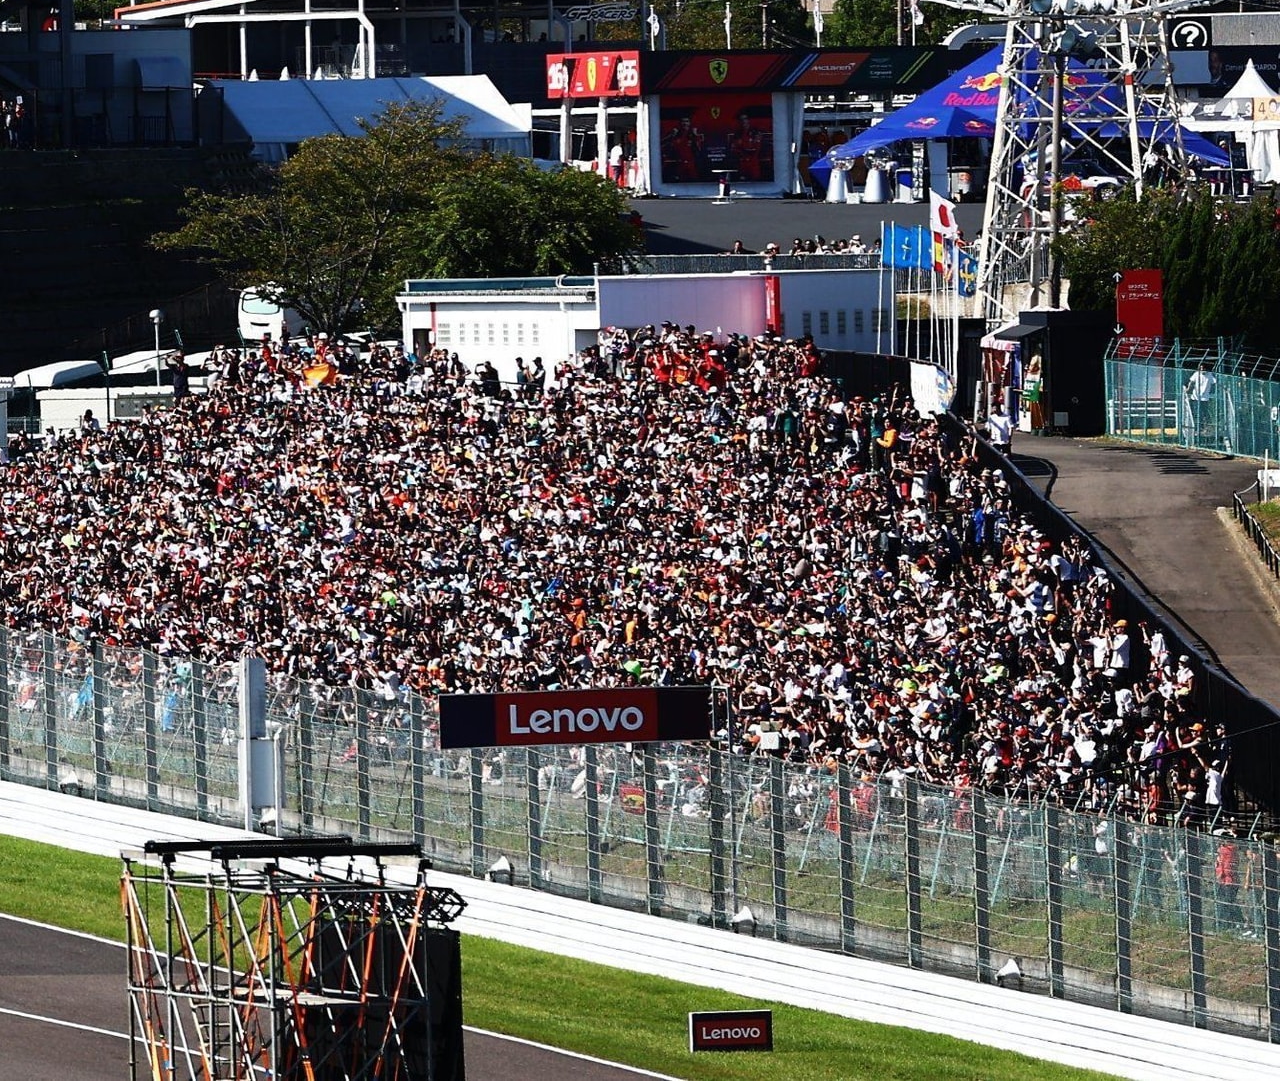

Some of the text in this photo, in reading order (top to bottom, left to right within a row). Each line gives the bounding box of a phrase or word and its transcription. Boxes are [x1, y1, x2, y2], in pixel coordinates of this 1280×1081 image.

[590, 7, 637, 20] RACERS
[548, 62, 564, 90] 16
[943, 92, 973, 106] Red
[509, 704, 644, 735] Lenovo
[702, 1025, 761, 1041] Lenovo
